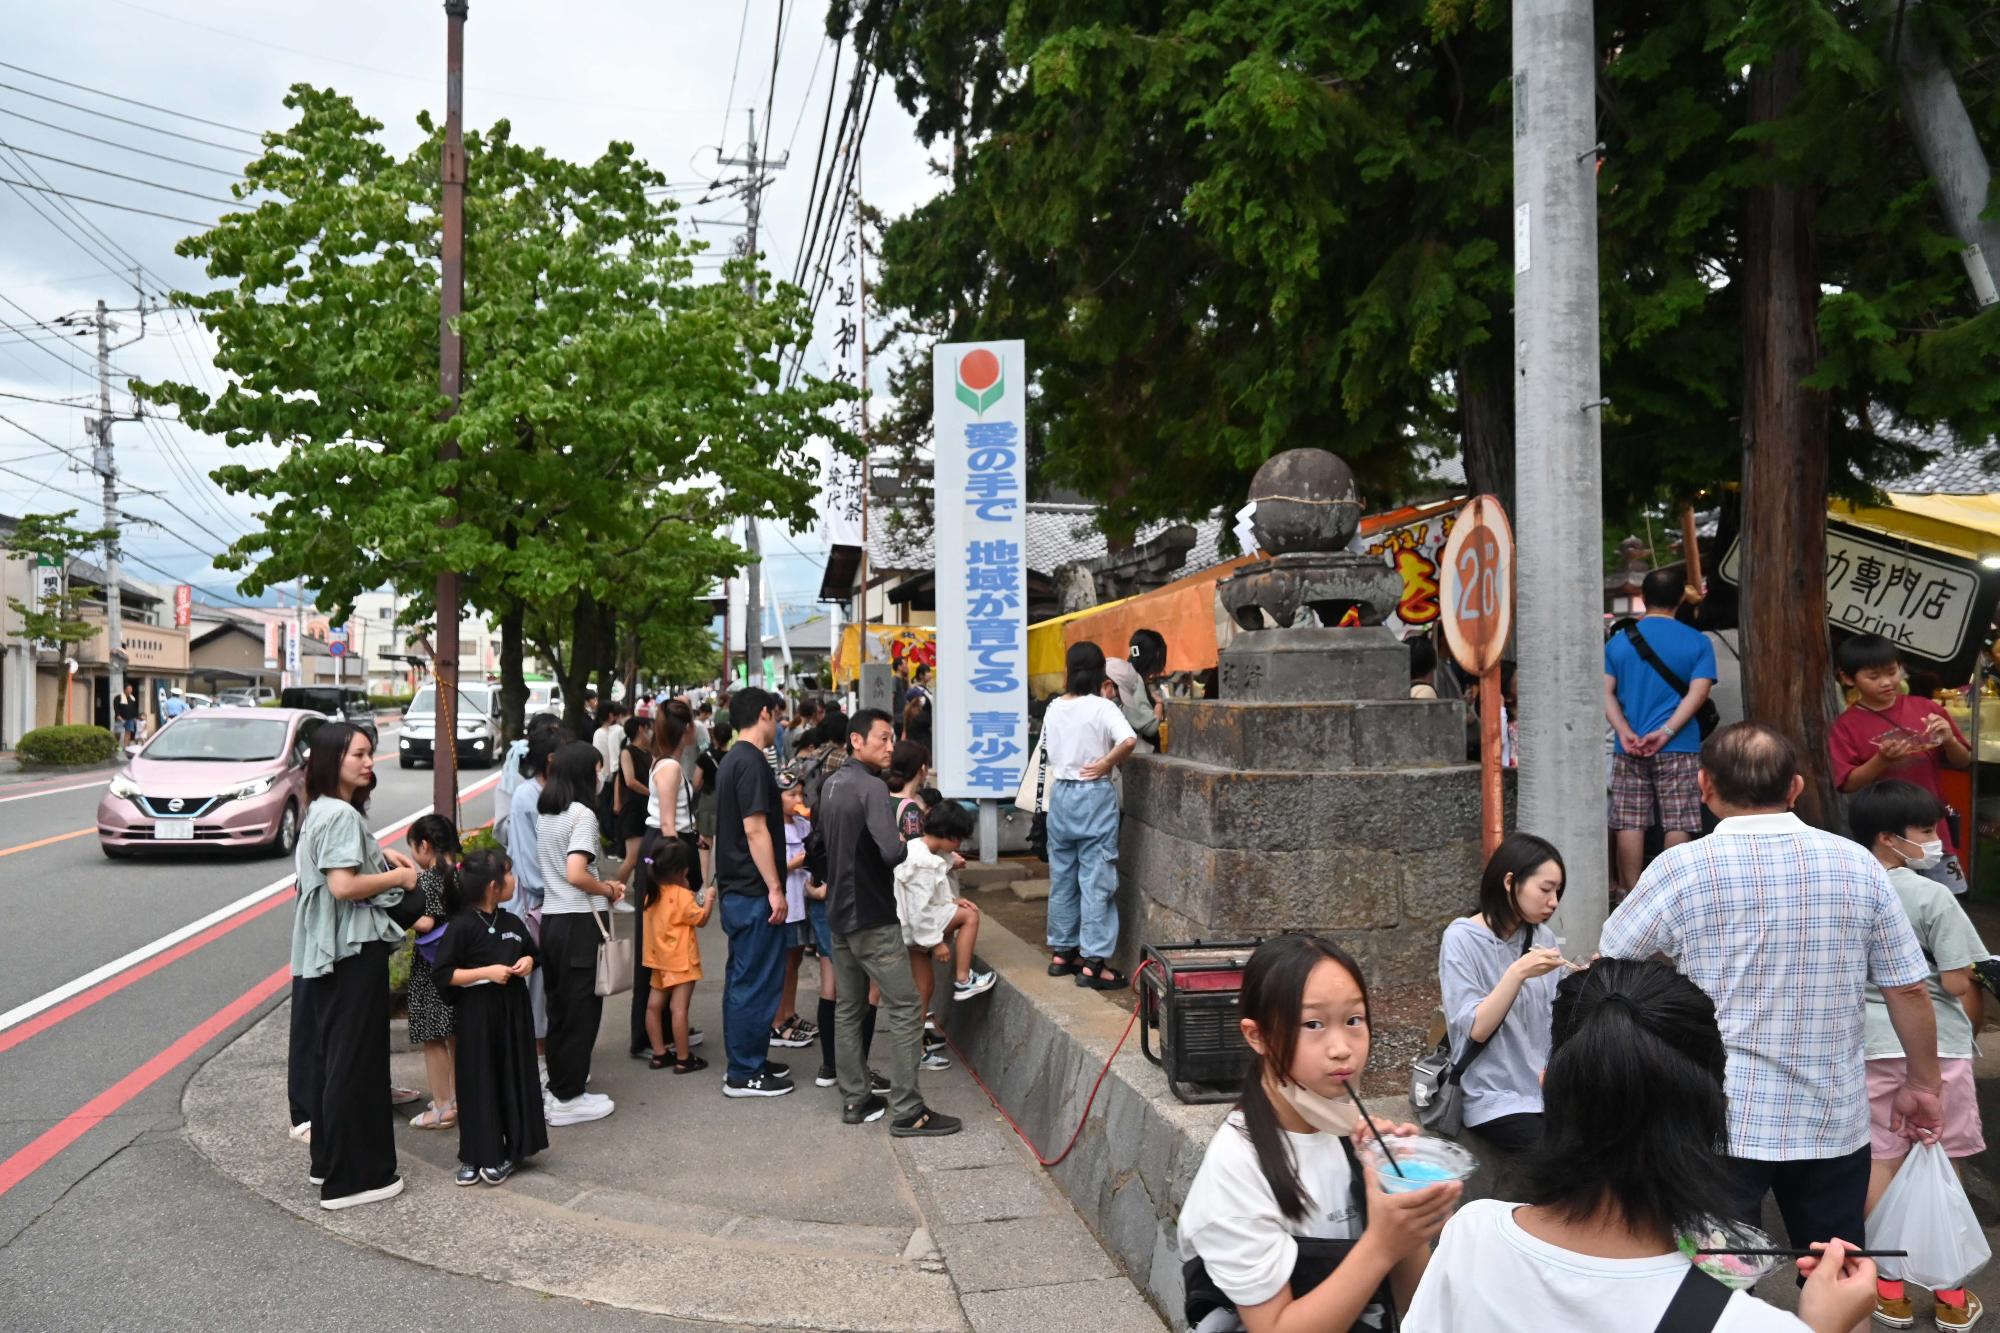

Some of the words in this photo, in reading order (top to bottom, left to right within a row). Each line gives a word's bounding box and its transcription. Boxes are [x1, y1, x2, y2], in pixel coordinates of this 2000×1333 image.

[964, 421, 1019, 522] 愛の手で
[966, 539, 1020, 693] 地域が育てる
[1842, 604, 1915, 645] Drink
[967, 711, 1022, 791] 青少年
